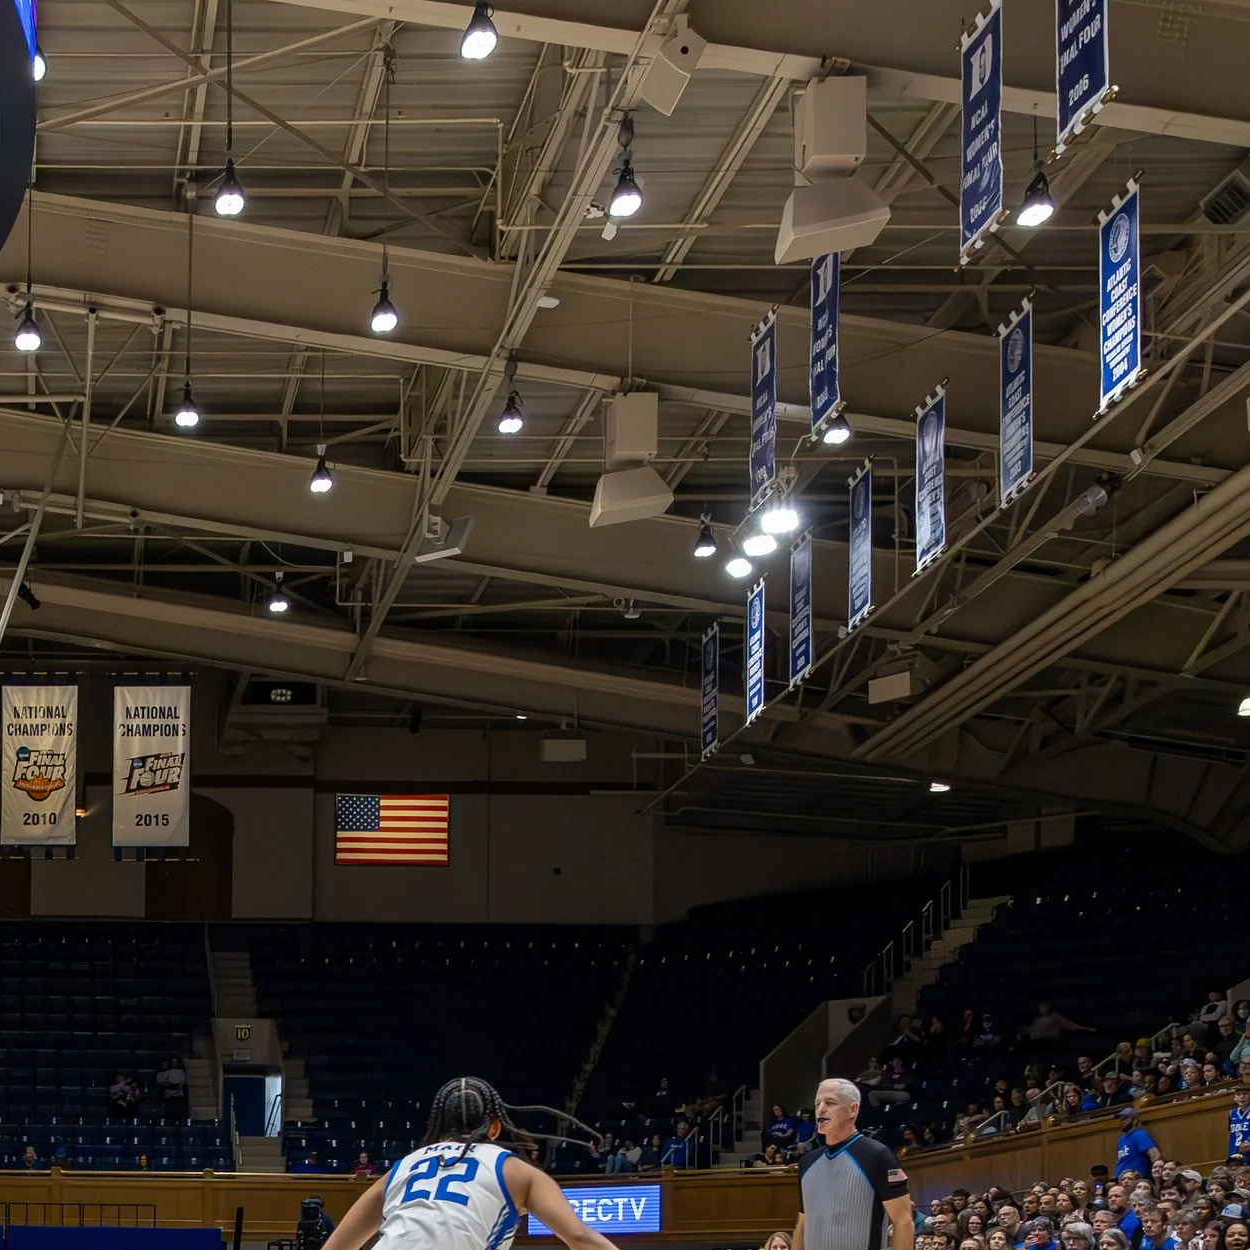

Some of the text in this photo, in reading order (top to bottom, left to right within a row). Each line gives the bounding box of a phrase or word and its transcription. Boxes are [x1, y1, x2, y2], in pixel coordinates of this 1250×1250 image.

[13, 705, 67, 720] NATIONAL
[125, 706, 180, 720] NATIONAL
[7, 722, 74, 737] CHAMPIONS
[118, 723, 187, 738] CHAMPIONS
[22, 812, 57, 826] 2010
[135, 813, 170, 827] 2015
[237, 1028, 249, 1039] 10
[400, 1155, 479, 1207] 22
